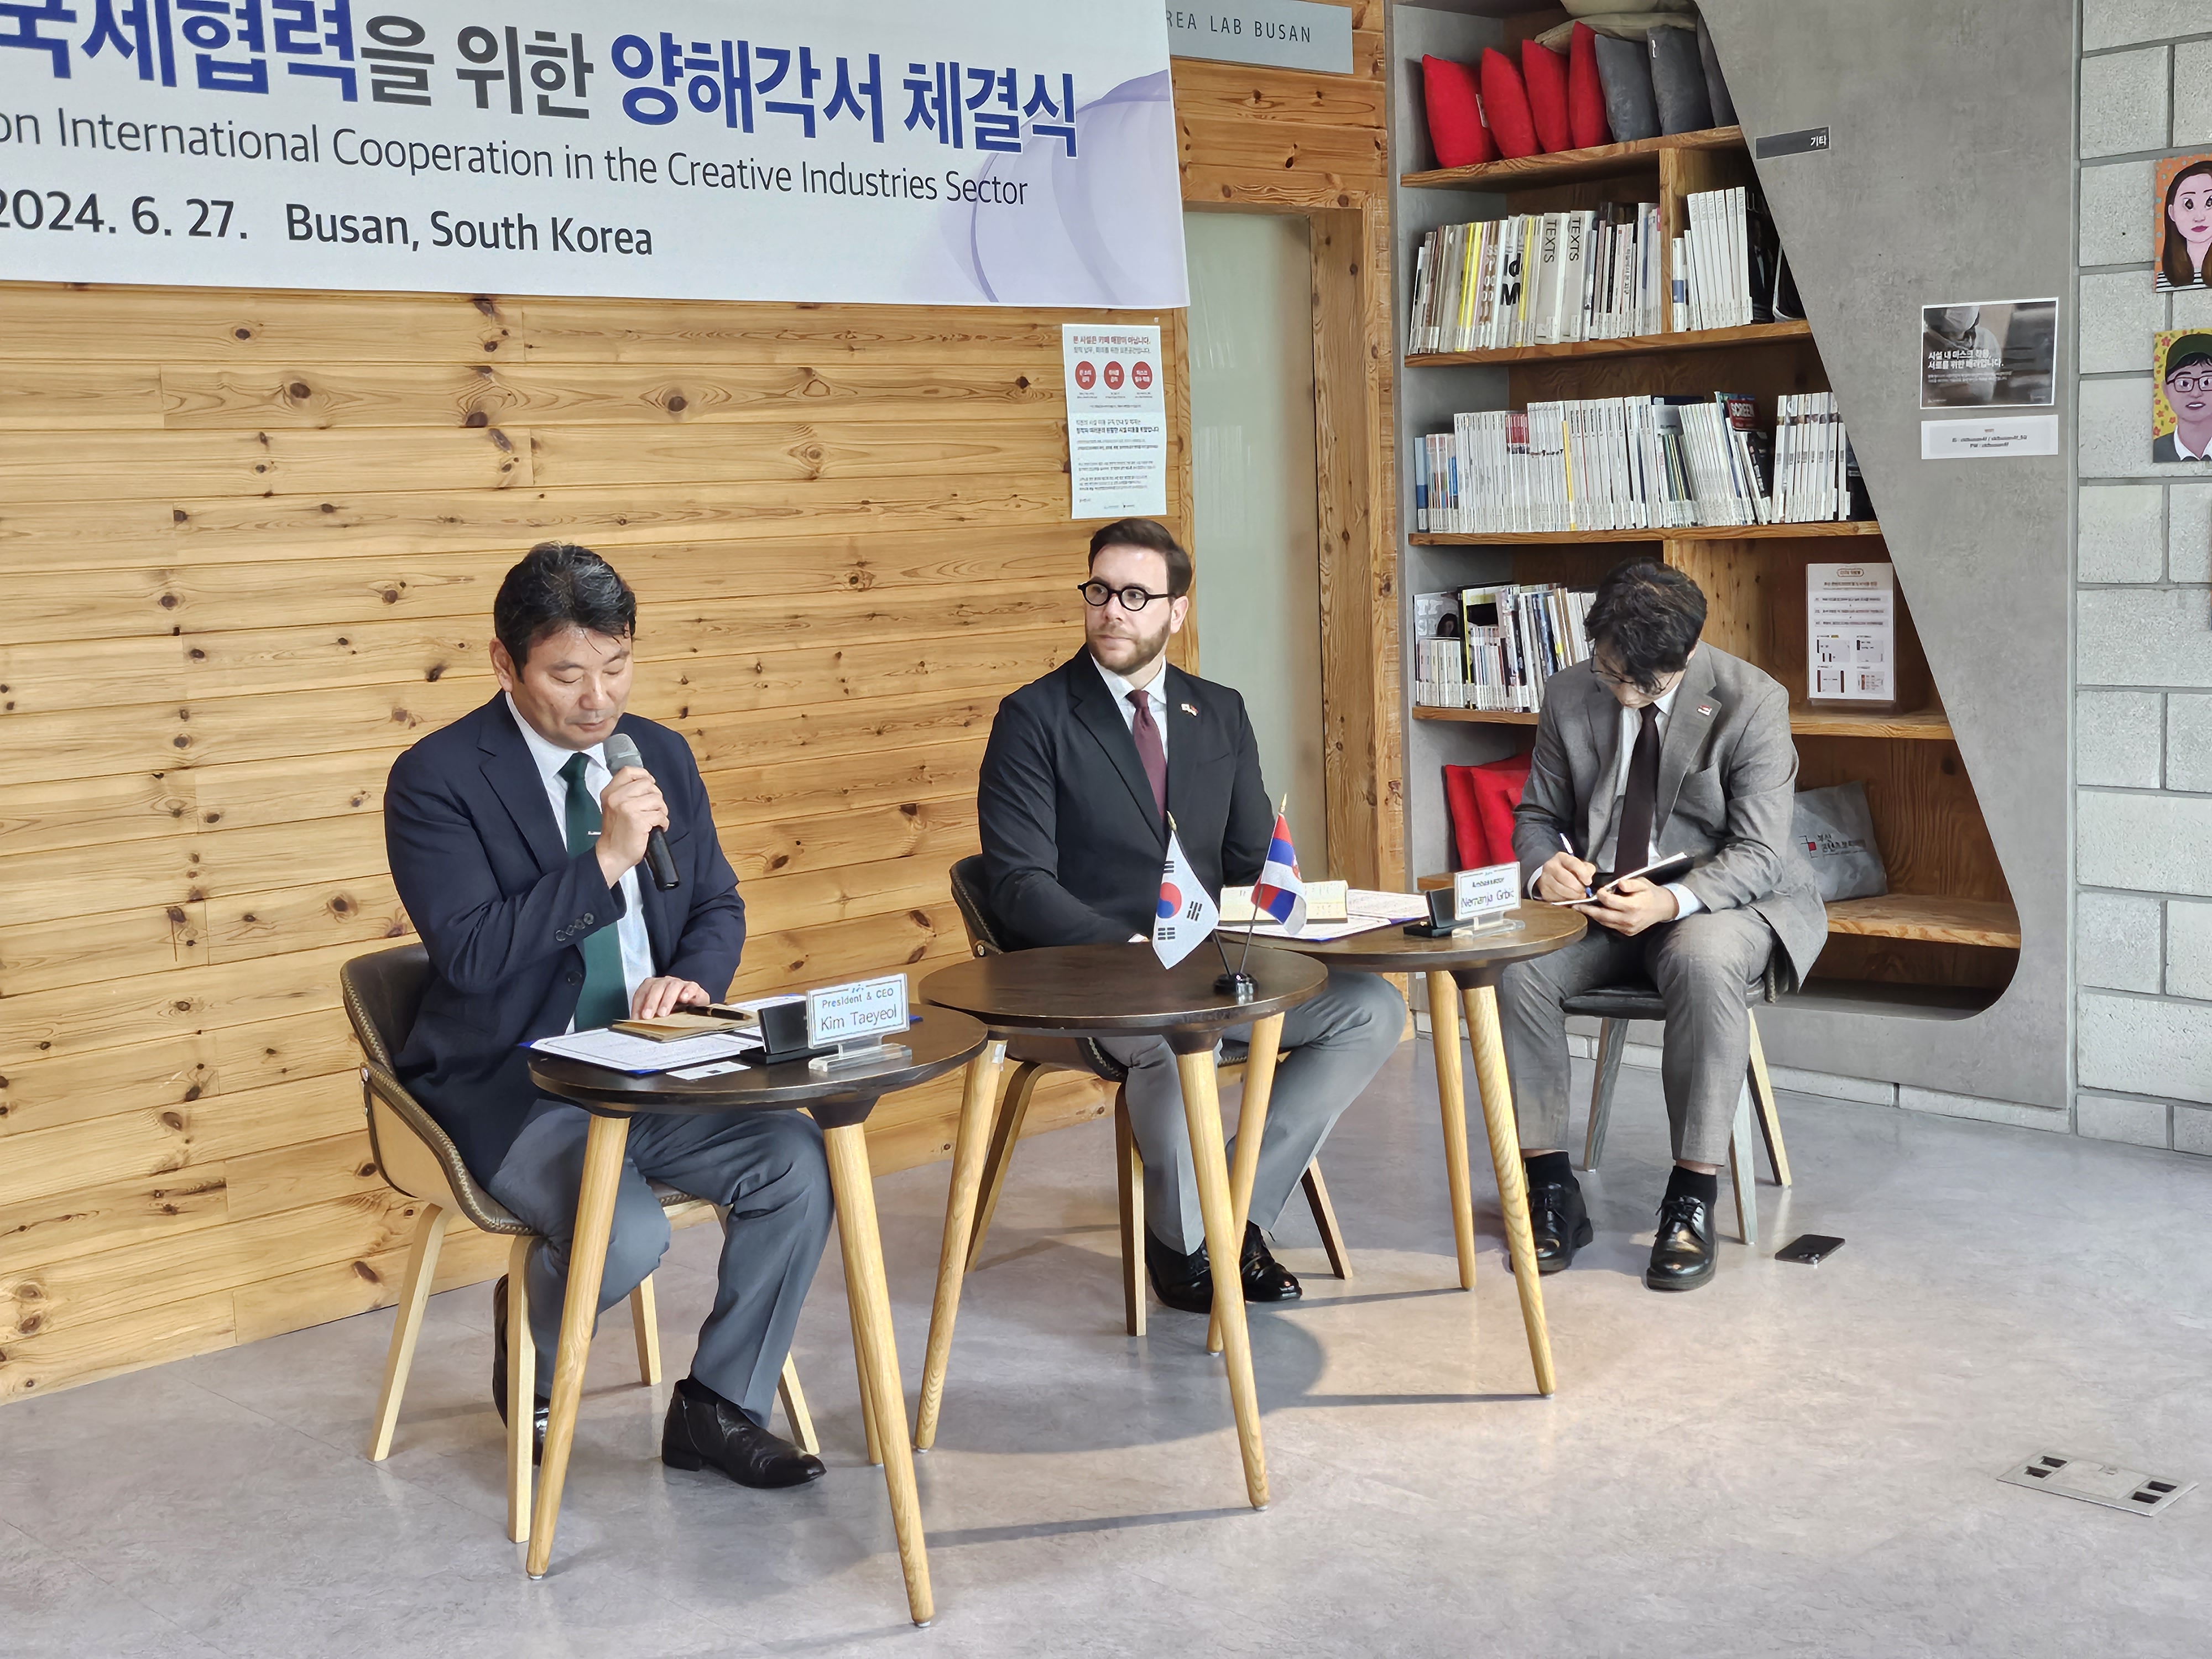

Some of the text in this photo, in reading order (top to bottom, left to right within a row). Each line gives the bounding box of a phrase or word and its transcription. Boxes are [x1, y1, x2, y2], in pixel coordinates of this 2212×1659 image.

[1211, 15, 1241, 34] LAB
[1255, 21, 1311, 43] BUSAN
[456, 26, 594, 119] 위한
[612, 32, 884, 143] 양해각서
[903, 61, 1078, 158] 체결식
[58, 107, 319, 163] International
[333, 128, 552, 179] Cooperation
[565, 145, 593, 180] in
[604, 147, 657, 184] the
[667, 152, 791, 192] Creative
[802, 161, 937, 200] Industries
[946, 171, 1028, 205] Sector
[1811, 135, 1827, 147] 기타
[132, 196, 171, 236] 6.
[186, 199, 247, 239] 27.
[286, 204, 419, 252] Busan,
[431, 210, 538, 251] South
[551, 217, 652, 255] Korea
[1544, 220, 1557, 263] TEXTS
[1569, 217, 1580, 261] TEXTS
[876, 987, 894, 999] CEO
[821, 1003, 897, 1031] Kim Taeyeol
